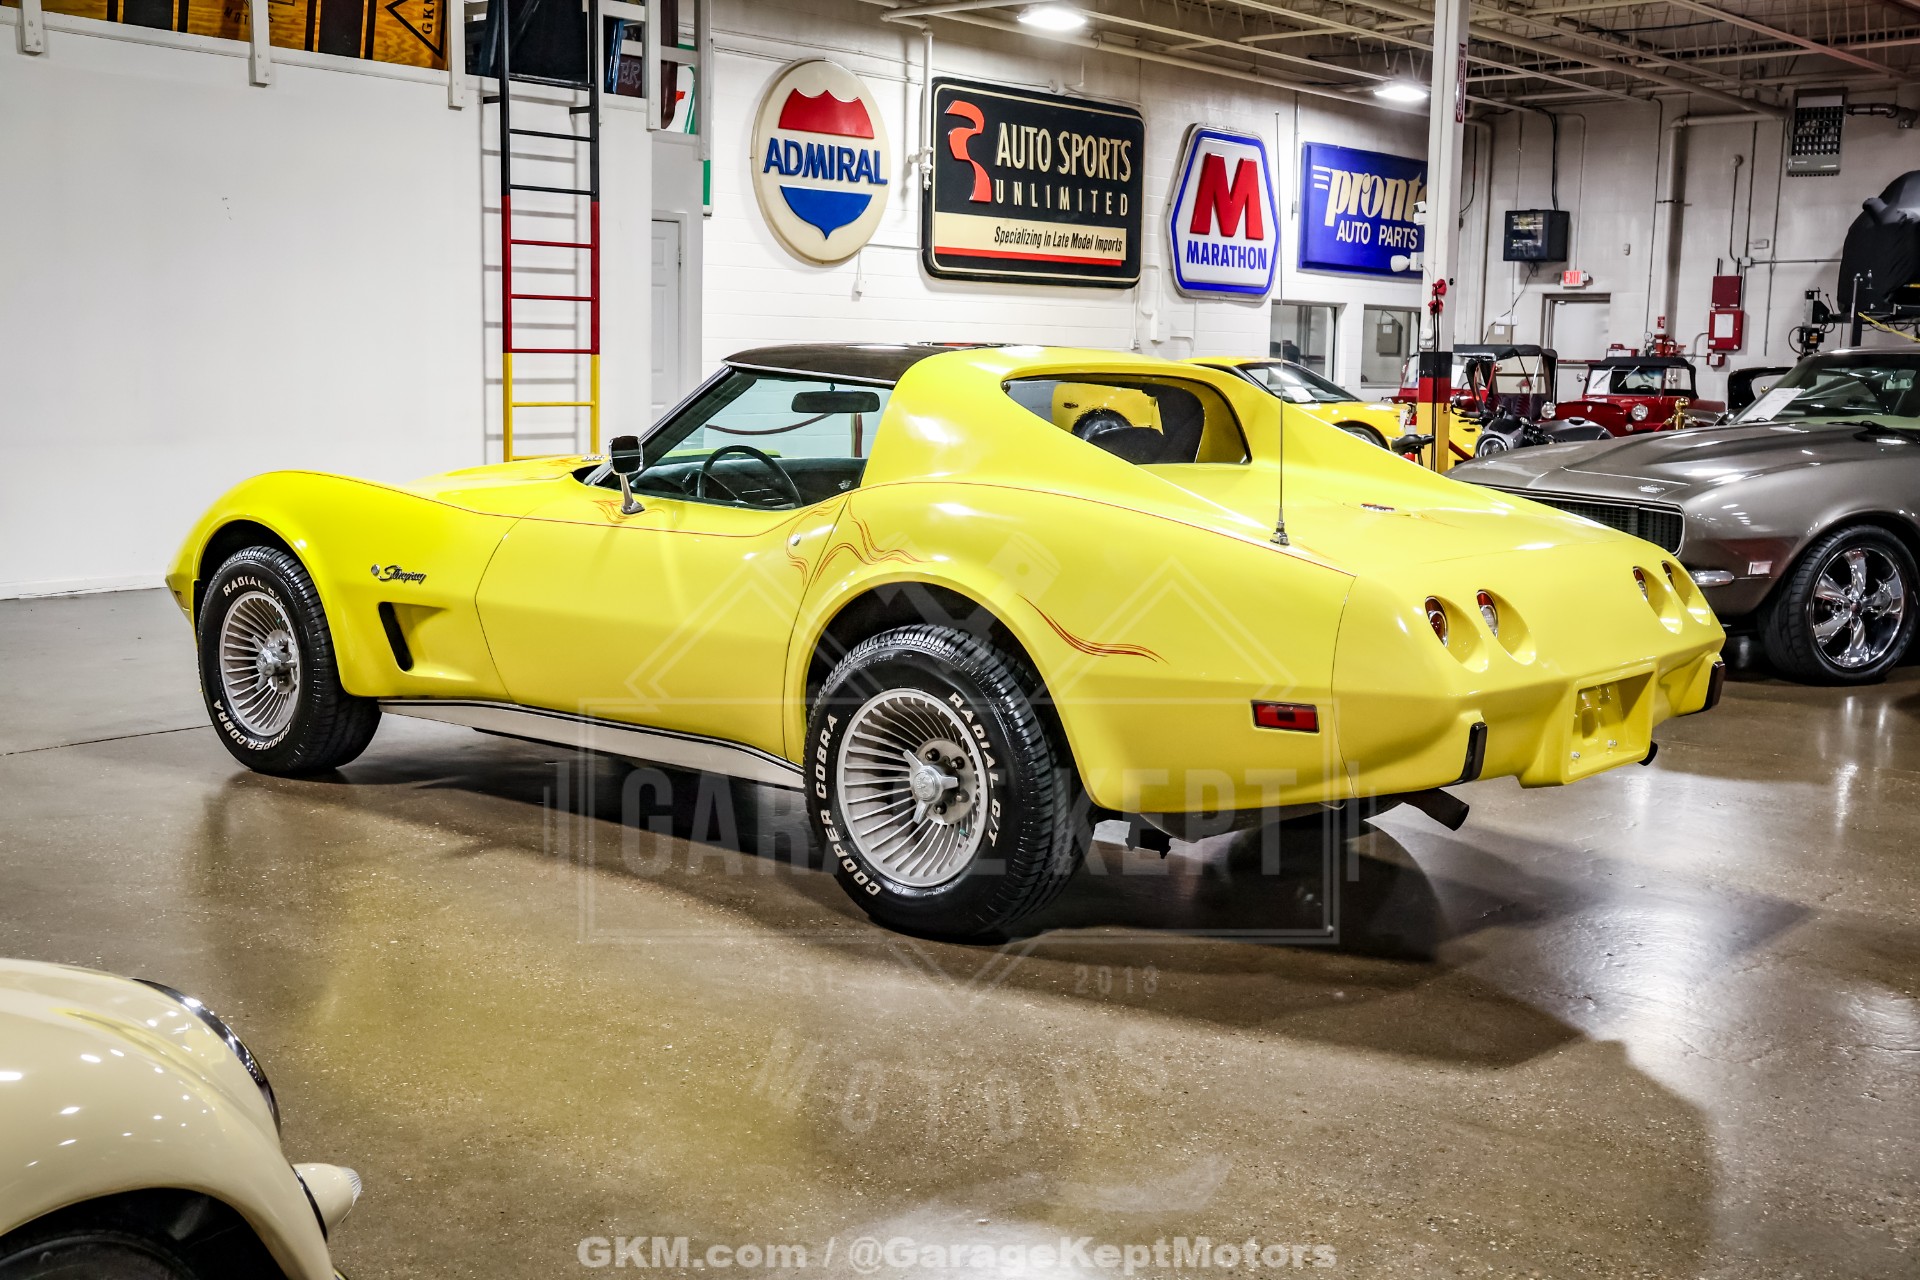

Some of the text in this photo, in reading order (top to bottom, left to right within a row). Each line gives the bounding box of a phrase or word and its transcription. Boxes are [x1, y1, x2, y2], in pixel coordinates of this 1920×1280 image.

[763, 137, 888, 185] ADMIRAL
[995, 122, 1132, 183] AUTO SPORTS
[994, 178, 1129, 217] UNLIMITED
[1189, 152, 1264, 241] M
[994, 226, 1123, 253] Specializing In Late Model Imports
[1186, 240, 1267, 271] MARATHON
[1335, 219, 1419, 250] AUTO PARTS
[1563, 270, 1581, 284] EXIT
[223, 576, 265, 597] RADIAL
[213, 700, 291, 751] COOPER COBRA
[949, 692, 1001, 847] RADIAL G/T
[815, 713, 882, 896] COOPER COBRA
